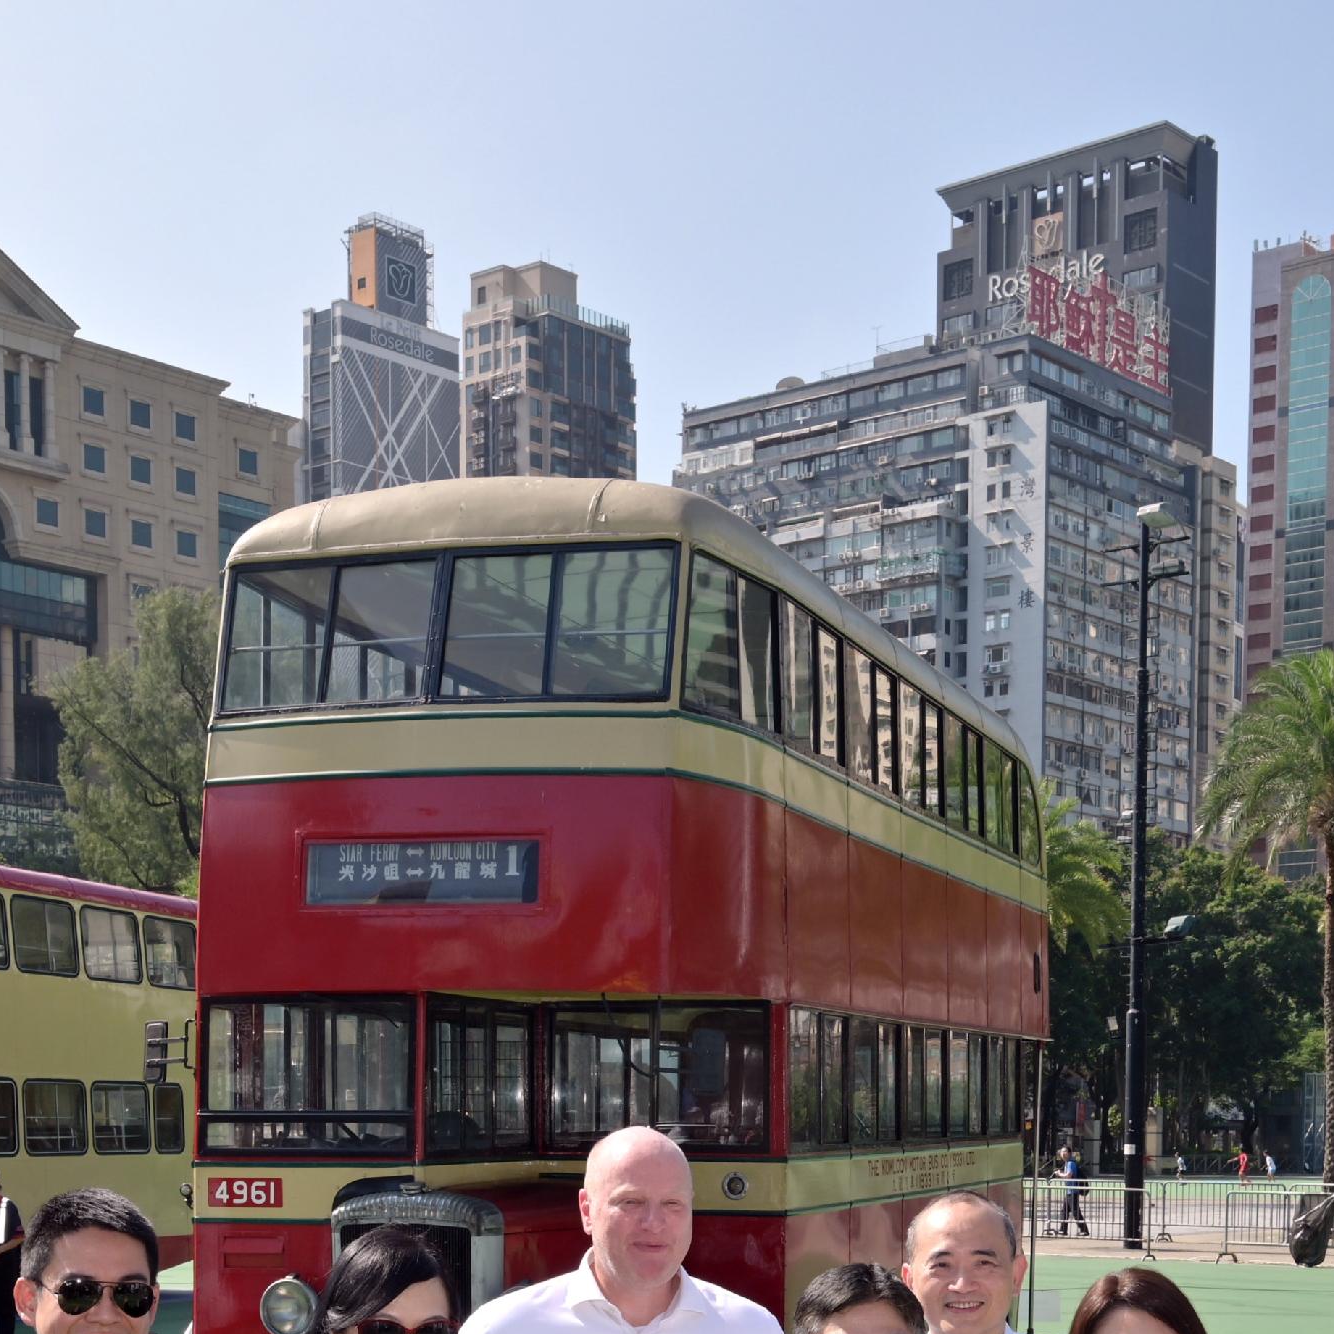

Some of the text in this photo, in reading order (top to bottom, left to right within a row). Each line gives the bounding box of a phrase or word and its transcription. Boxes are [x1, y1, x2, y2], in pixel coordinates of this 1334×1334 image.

[988, 250, 1105, 302] Rosdale
[370, 327, 435, 362] Rosedale
[339, 844, 363, 862] STAR
[370, 843, 400, 862] FERRY
[475, 842, 498, 860] CITY
[505, 845, 521, 876] 1
[215, 1180, 275, 1204] 4961
